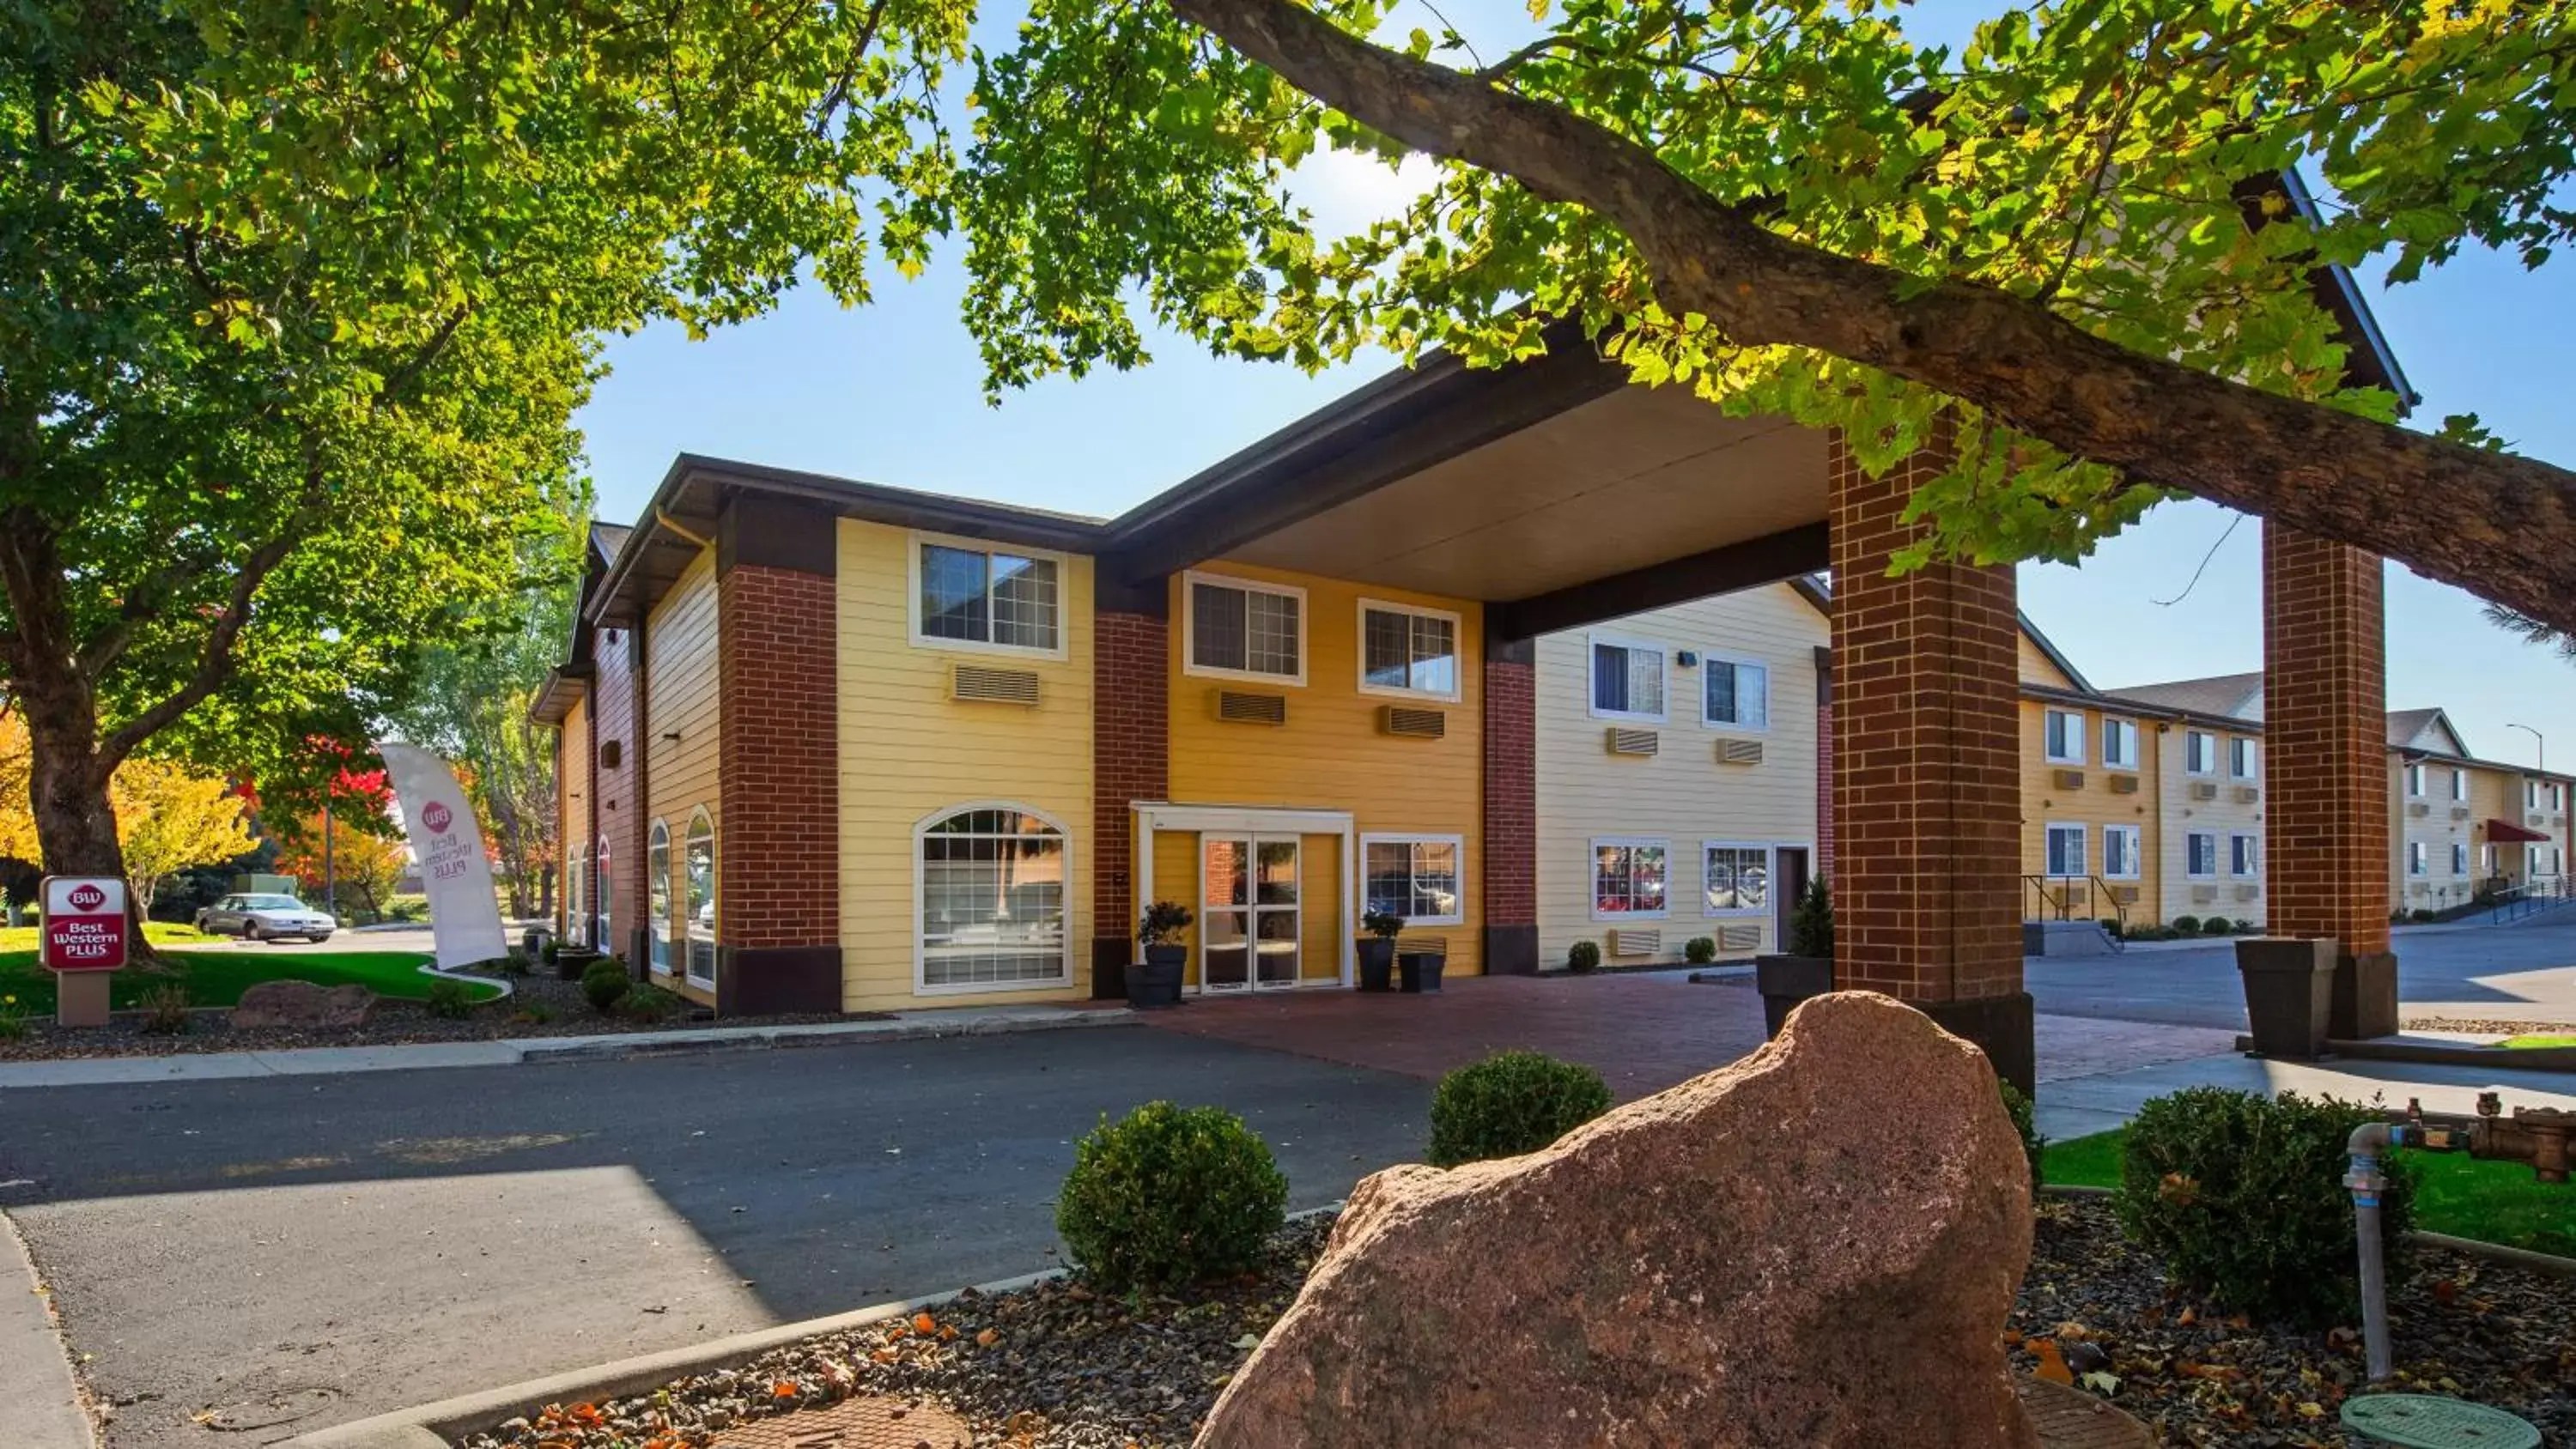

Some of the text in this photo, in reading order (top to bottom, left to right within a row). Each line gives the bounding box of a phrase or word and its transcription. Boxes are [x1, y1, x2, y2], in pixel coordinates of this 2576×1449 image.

[73, 892, 100, 904] BW
[70, 923, 105, 933] Best
[54, 933, 118, 944] Western
[66, 944, 107, 956] PLUS
